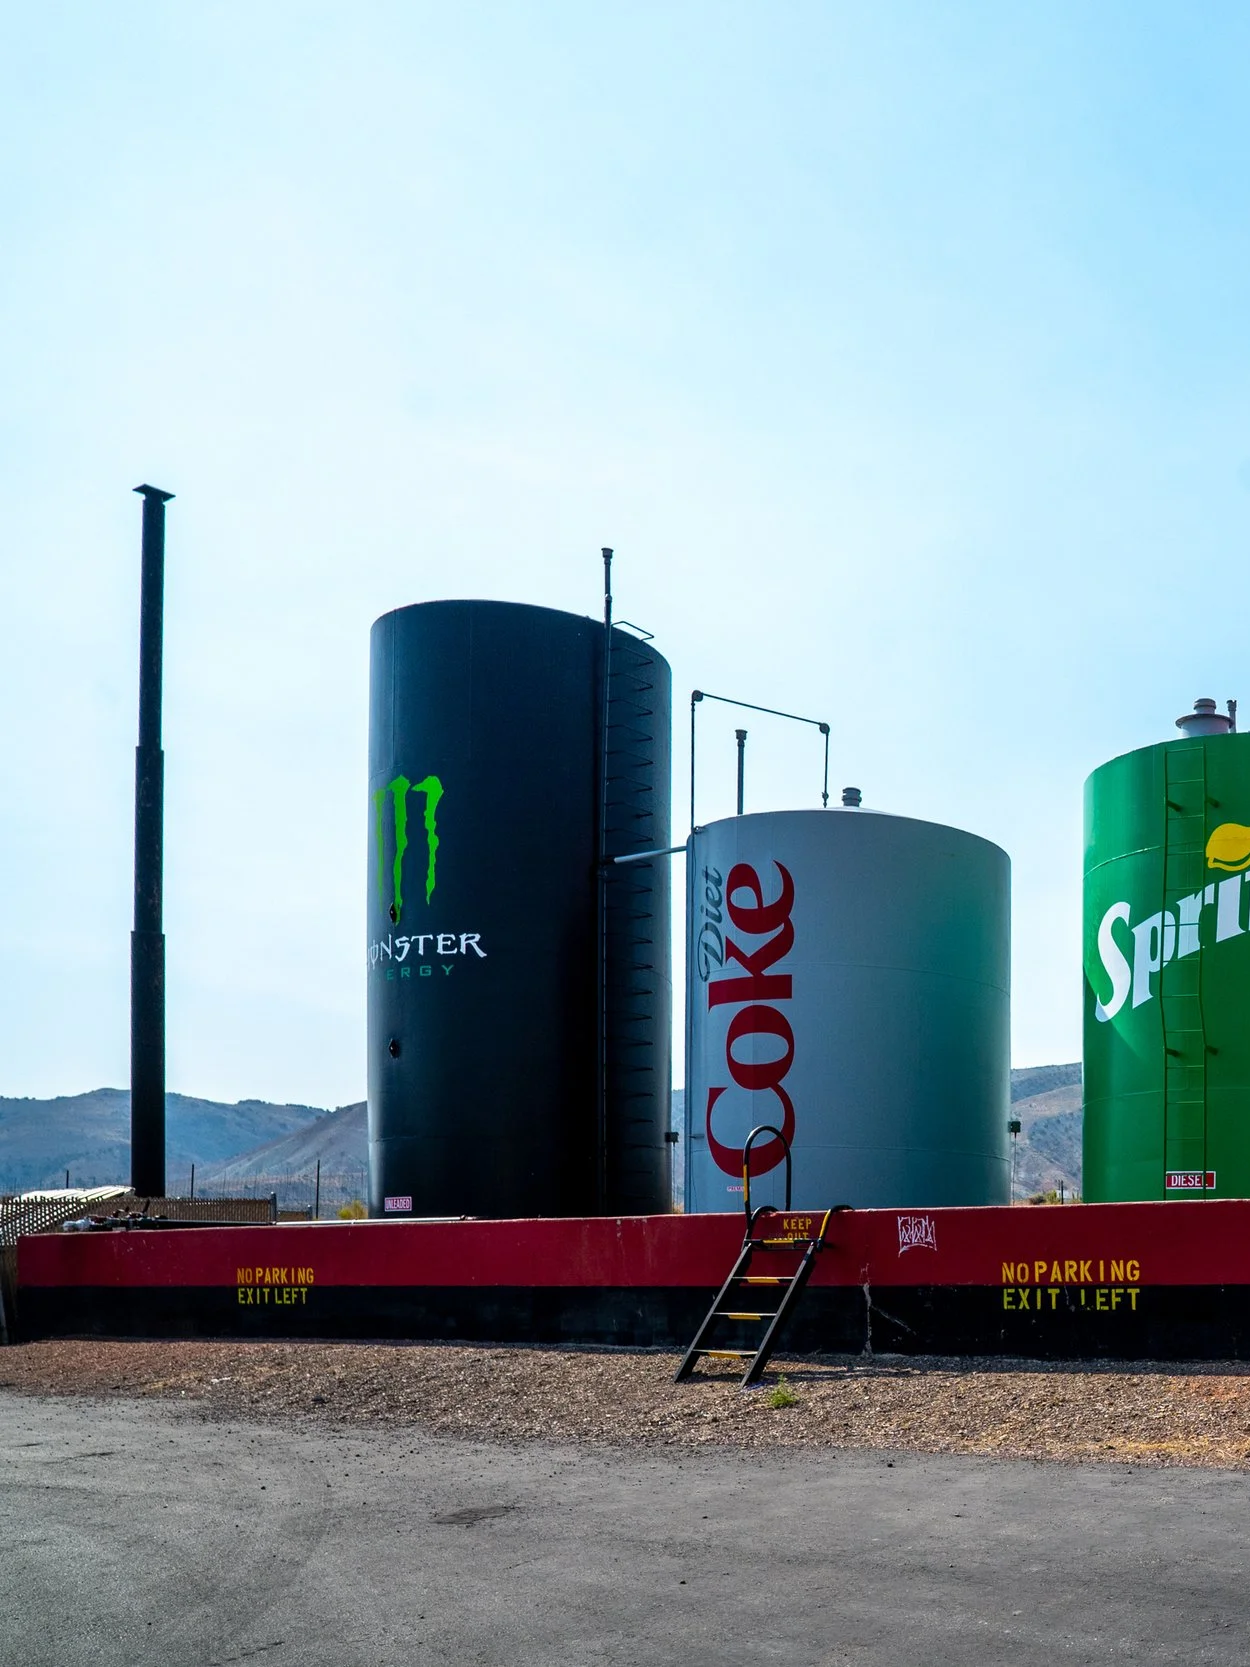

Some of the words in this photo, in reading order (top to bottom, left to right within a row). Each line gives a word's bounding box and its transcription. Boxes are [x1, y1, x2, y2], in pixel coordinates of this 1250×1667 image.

[697, 864, 724, 983] Diet
[367, 932, 488, 971] ONSTER
[386, 964, 455, 981] ERGY
[705, 859, 796, 1179] Coke
[385, 1198, 411, 1210] UNLEADED
[783, 1218, 812, 1230] KEEP
[237, 1267, 253, 1284] NO
[255, 1267, 315, 1284] PARKING
[1002, 1262, 1030, 1283] NO
[1034, 1260, 1140, 1283] PARKING
[238, 1287, 270, 1304] EXIT
[274, 1287, 308, 1304] LEFT
[1003, 1288, 1061, 1310] EXIT
